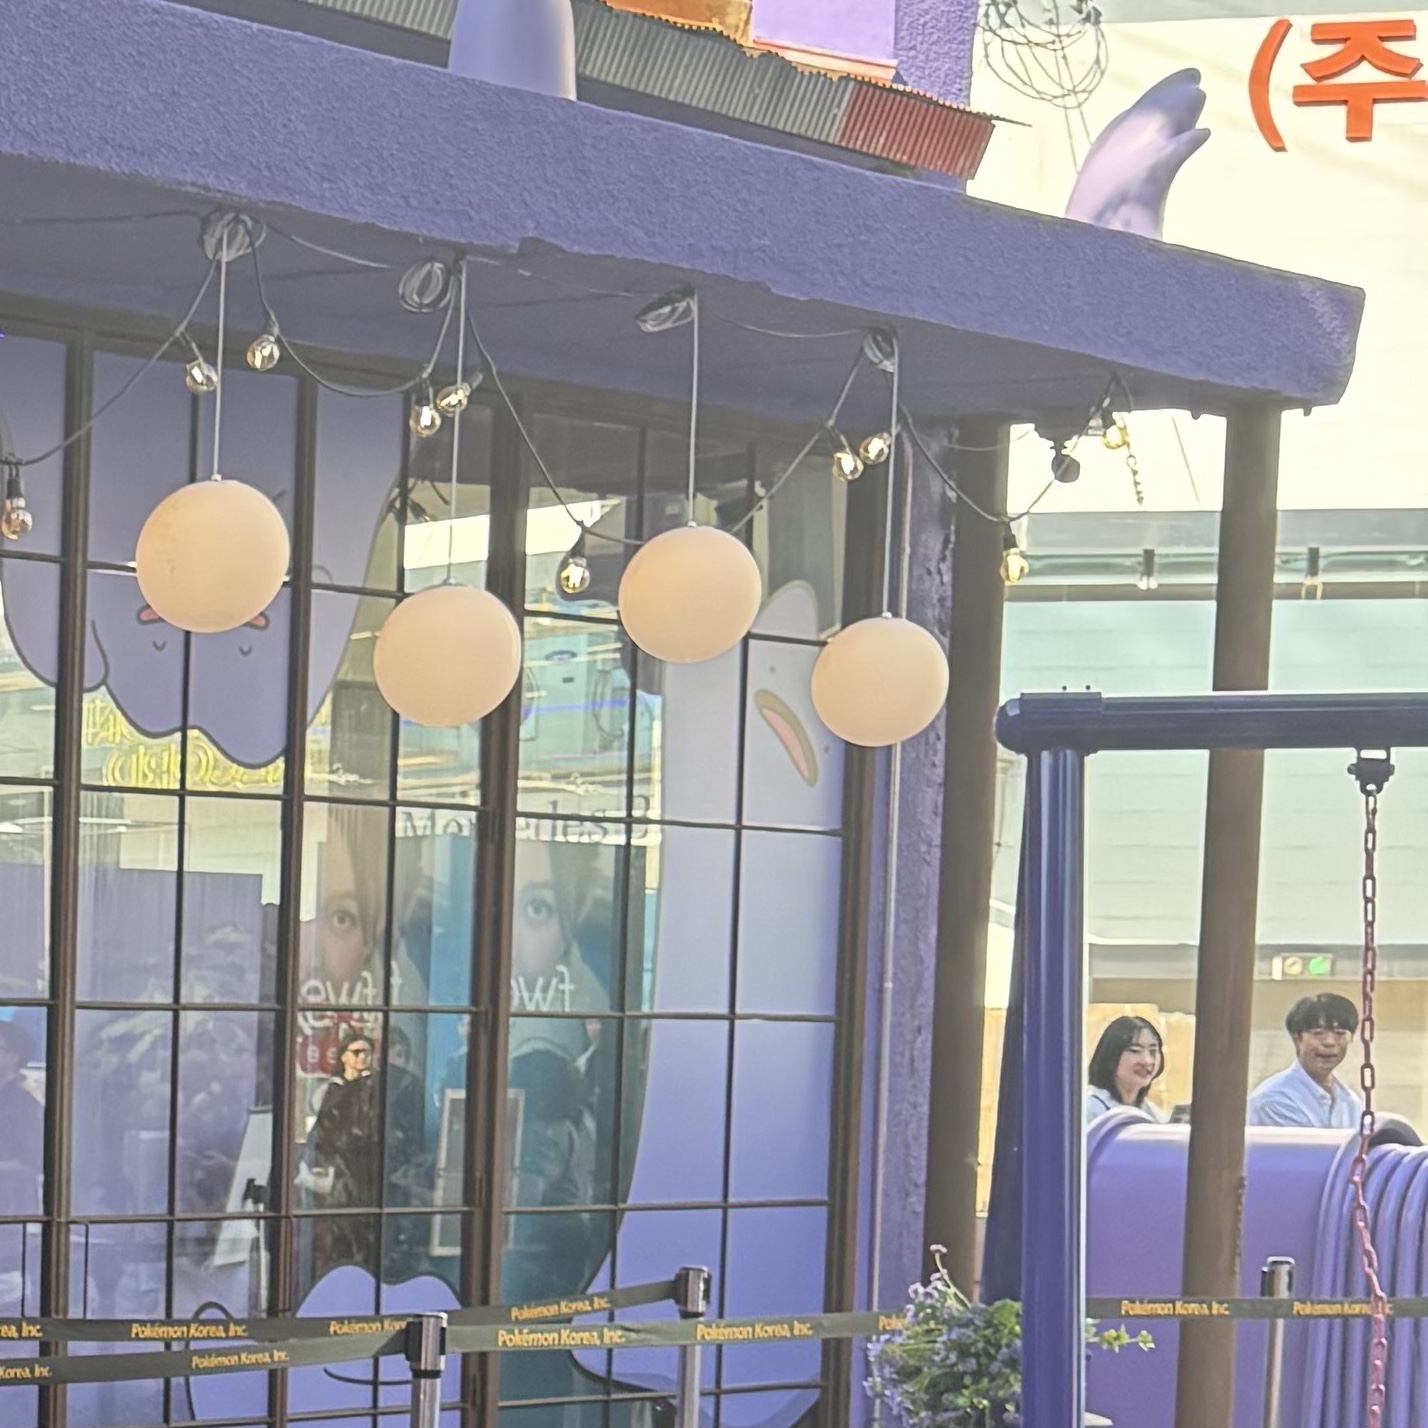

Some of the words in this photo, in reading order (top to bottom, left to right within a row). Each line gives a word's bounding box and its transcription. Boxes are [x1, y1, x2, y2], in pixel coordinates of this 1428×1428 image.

[1249, 18, 1428, 152] (주
[21, 1321, 43, 1338] Inc.
[131, 1322, 187, 1339] Pokémon
[498, 1328, 558, 1347] Pokémon
[560, 1328, 600, 1347] Korea,
[603, 1327, 625, 1344] Inc.
